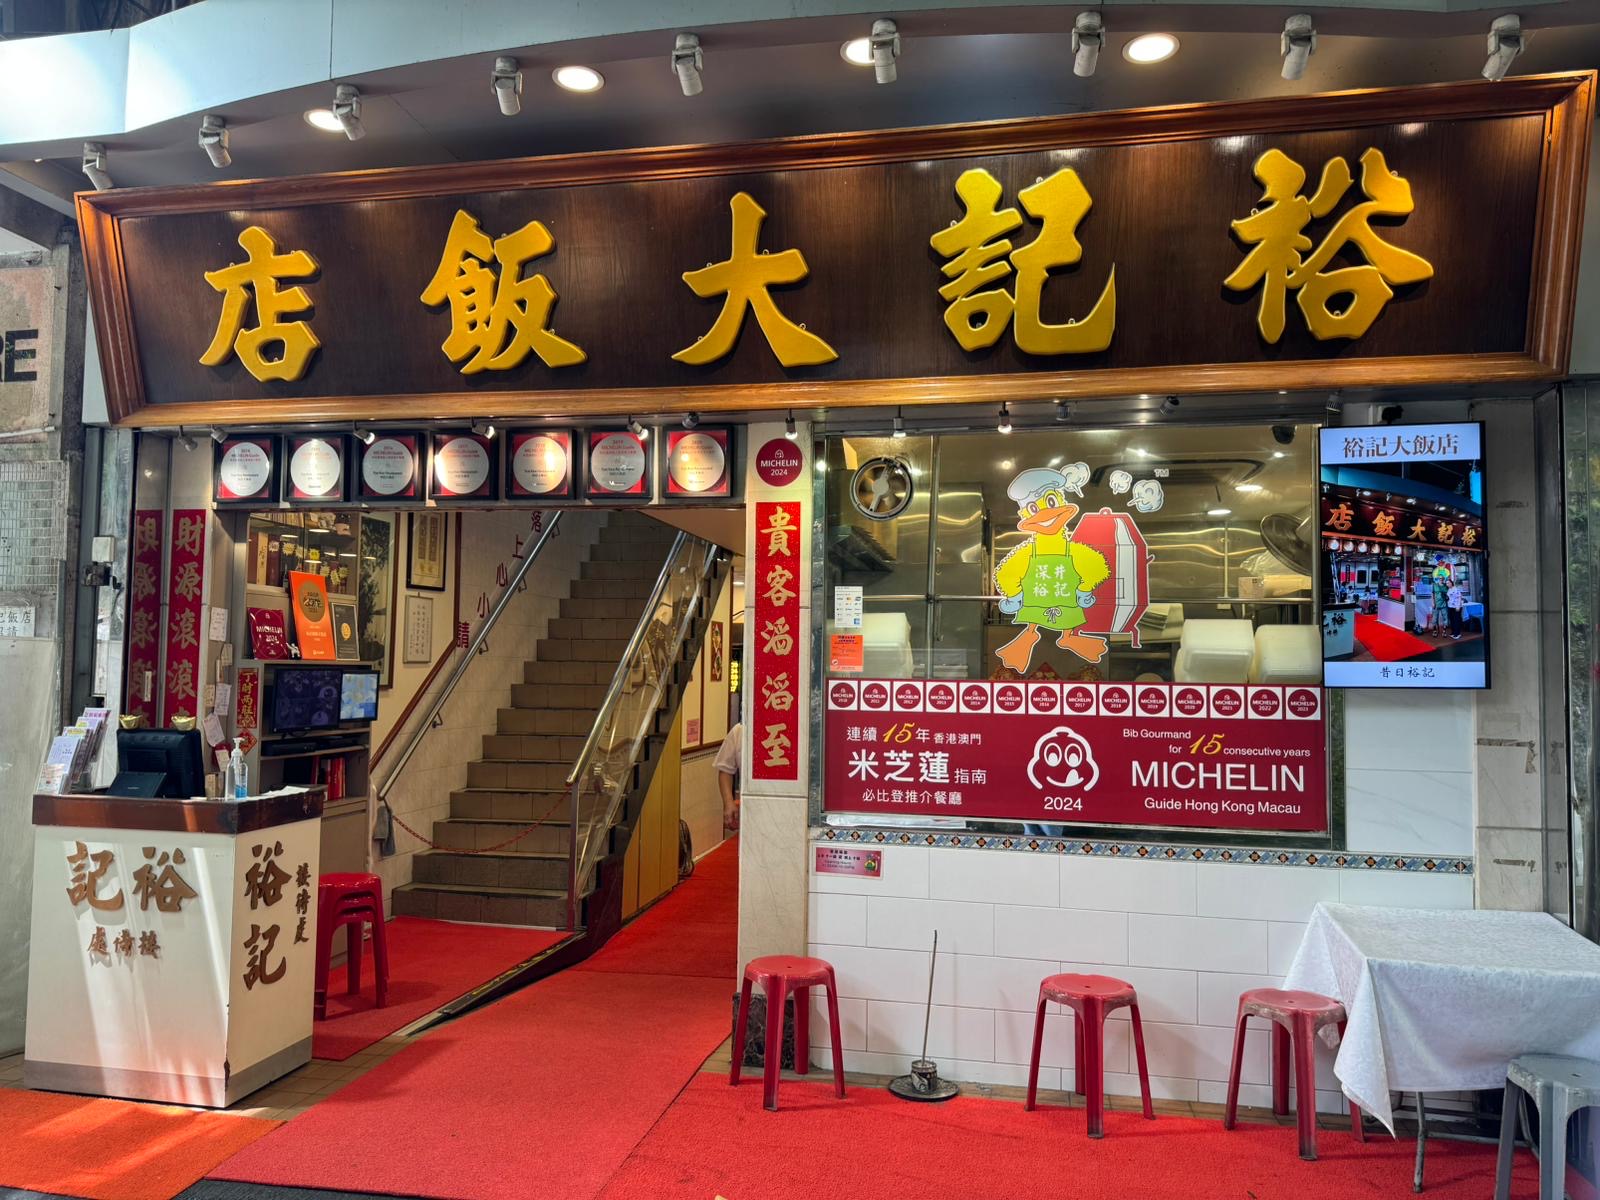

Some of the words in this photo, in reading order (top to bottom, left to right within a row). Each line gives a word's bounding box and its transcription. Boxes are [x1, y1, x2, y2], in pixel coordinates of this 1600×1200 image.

[0, 328, 39, 384] E
[1343, 433, 1459, 459] 裕記大飯店
[760, 459, 798, 468] MICHELIN
[1035, 564, 1067, 581] 深井
[1033, 582, 1071, 598] 裕記
[256, 625, 283, 635] MICHELIN
[760, 506, 798, 768] 貴客滔滔至
[1379, 666, 1436, 679] 昔日裕記
[1123, 729, 1139, 738] Bib
[1140, 729, 1192, 740] Gourmand
[1169, 744, 1182, 753] for
[1189, 733, 1225, 755] 15
[1223, 747, 1282, 757] consecutive
[1283, 749, 1311, 758] years
[848, 749, 950, 784] 米芝蓮
[1131, 760, 1305, 793] MICHELIN
[862, 788, 963, 806] 必比登推介餐廳
[1043, 796, 1083, 811] 2024
[1144, 797, 1182, 810] Guide
[1184, 799, 1219, 814] Hong
[1221, 800, 1255, 815] Kong
[1257, 801, 1301, 815] Macau
[66, 840, 199, 913] 裕記
[244, 841, 293, 991] 裕記
